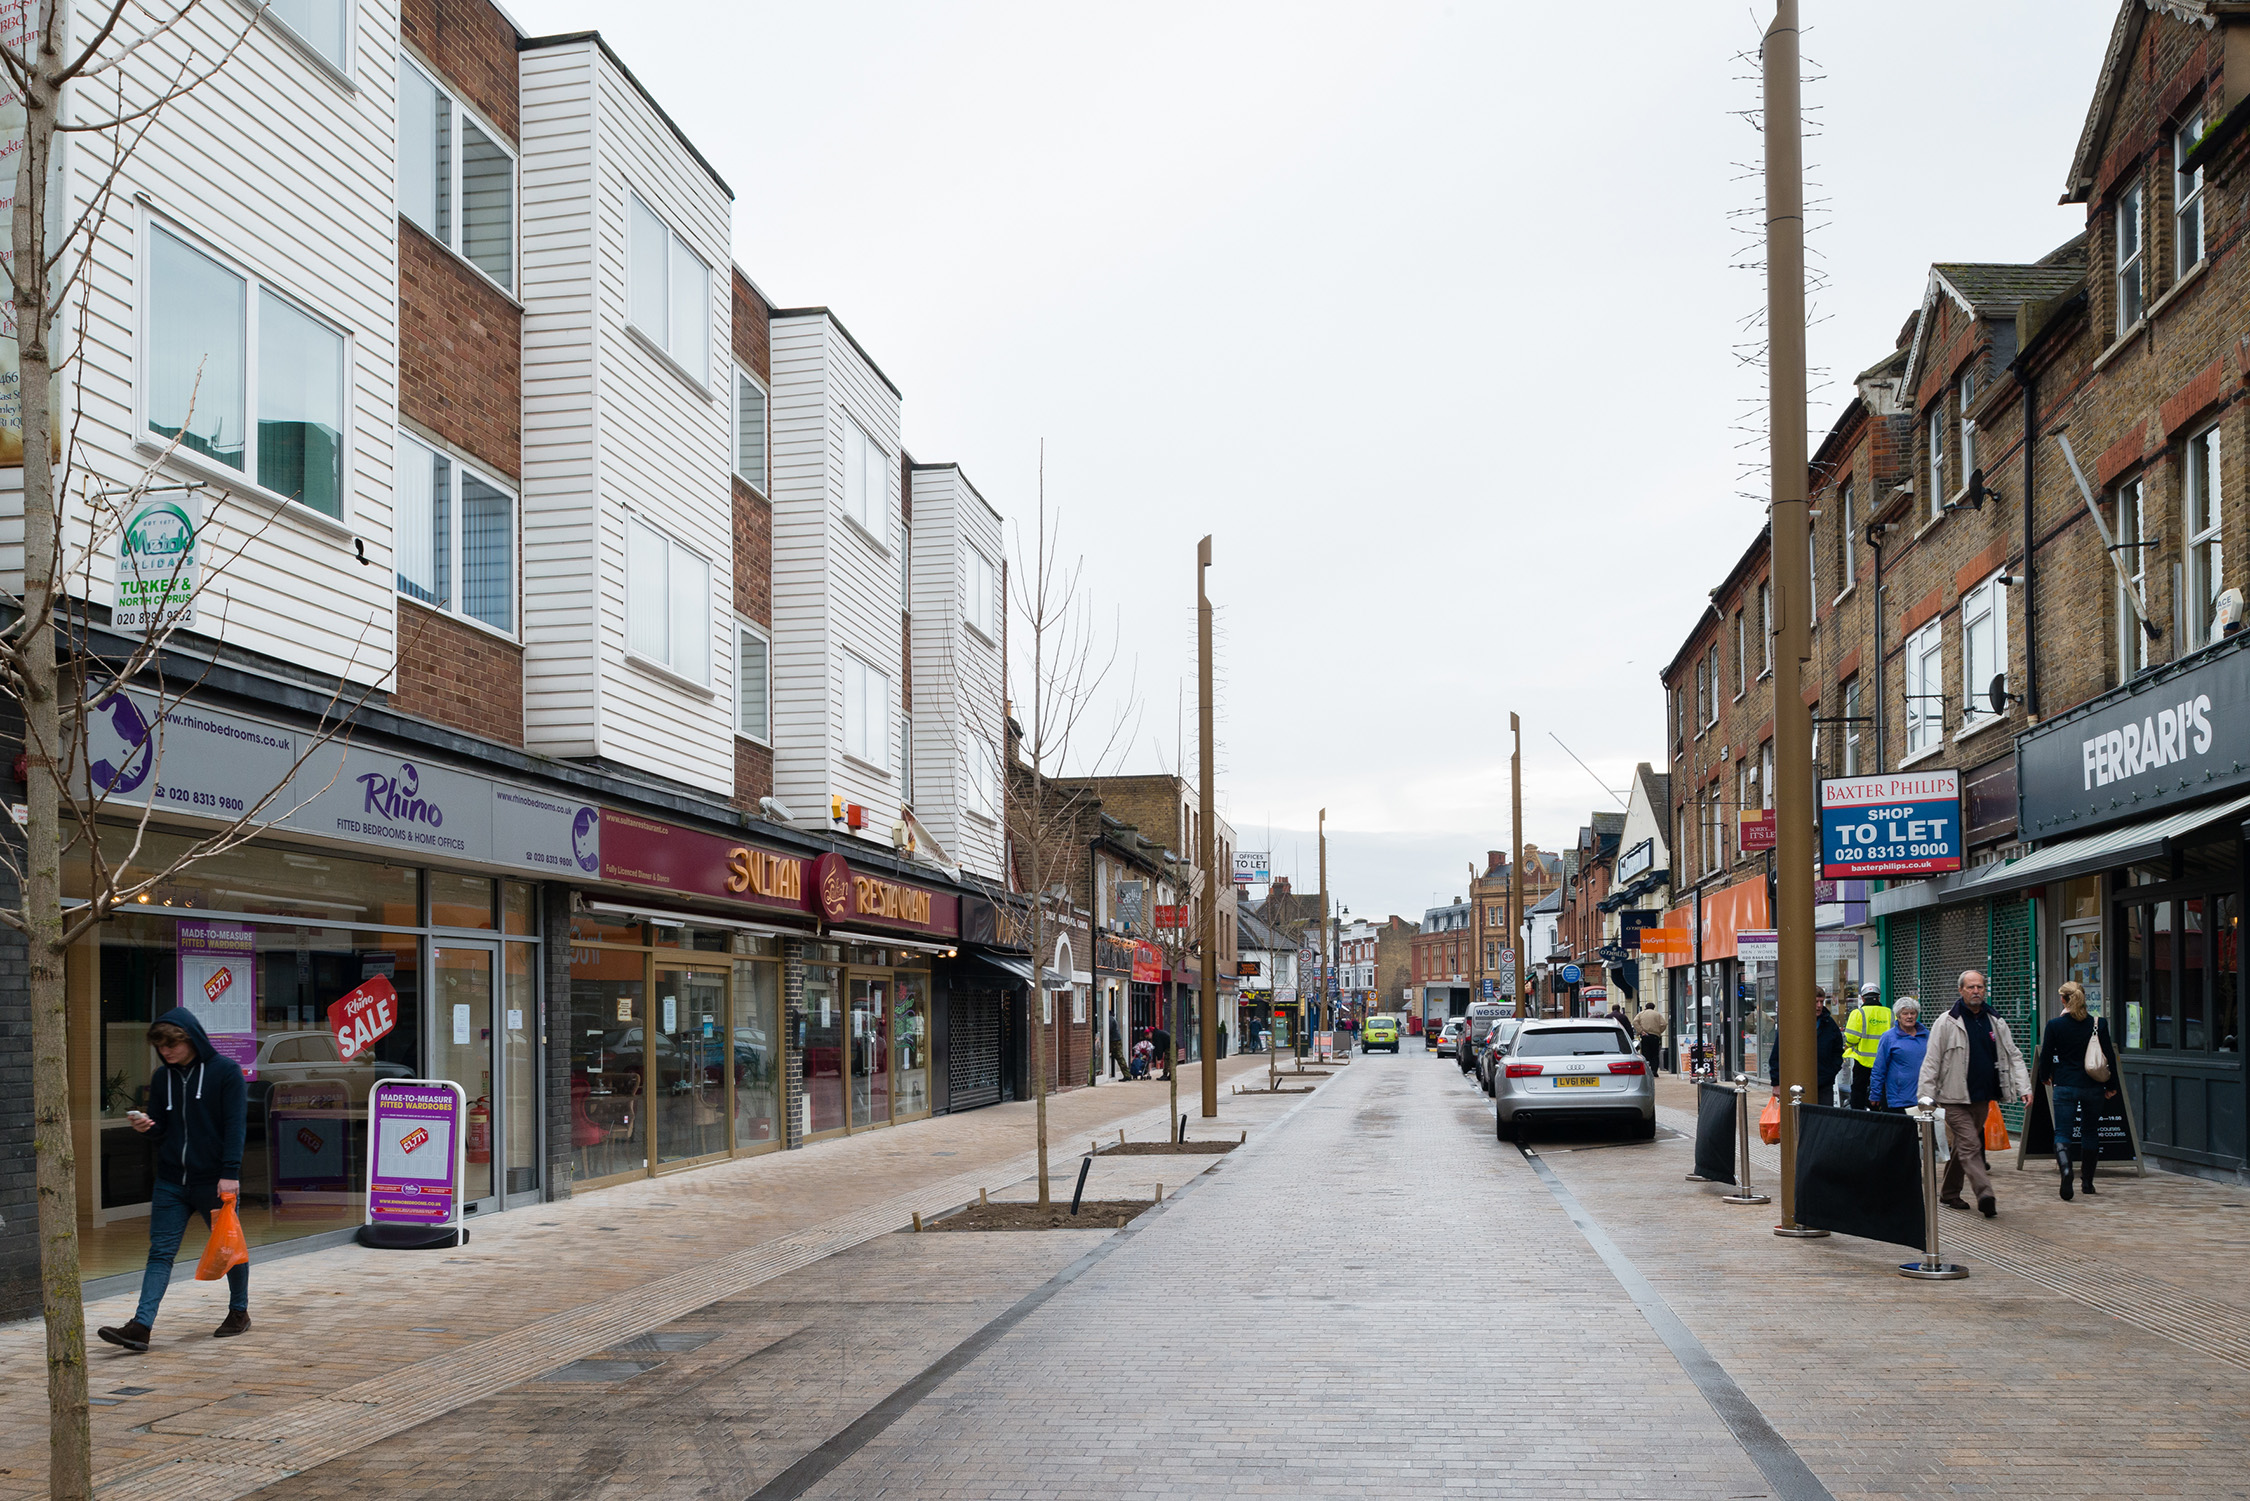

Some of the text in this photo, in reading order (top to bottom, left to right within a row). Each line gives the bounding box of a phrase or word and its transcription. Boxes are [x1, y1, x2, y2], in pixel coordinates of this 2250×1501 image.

[121, 577, 191, 595] TURKEY &
[119, 596, 152, 608] NORTH
[117, 613, 136, 626] 020
[154, 709, 290, 750] www.rhinobedrooms.co.uk
[2083, 694, 2213, 791] FERRARI'S
[1826, 778, 1955, 801] BAXTER PHILIPS
[169, 787, 244, 812] 020 8313 9800
[356, 772, 443, 828] Rhino
[497, 791, 573, 816] www.rhinobedrooms.co.uk
[1868, 807, 1914, 821] SHOP
[337, 818, 465, 851] FITTED BEDROOMS & HOME OFFICES
[1835, 819, 1948, 845] TO LET
[534, 853, 573, 867] 020 8313 9800
[1835, 842, 1949, 861] 020 8313 9000
[606, 864, 617, 876] Fully
[1235, 860, 1267, 868] TO LET
[1851, 861, 1932, 872] baxterphilips.co.uk
[728, 847, 800, 901] SULTAN
[854, 875, 932, 925] RESTAURANT
[181, 928, 252, 941] MADE-TO-MEASURE
[1642, 937, 1665, 945] truGym
[181, 938, 253, 950] FITTED WARDROBES
[344, 993, 374, 1017] Rhino
[338, 999, 393, 1058] SALE
[1559, 1077, 1596, 1086] LV61 RNF
[380, 1094, 453, 1104] MADE-TO-MEASURE
[380, 1101, 453, 1111] FITTED WARDROBES
